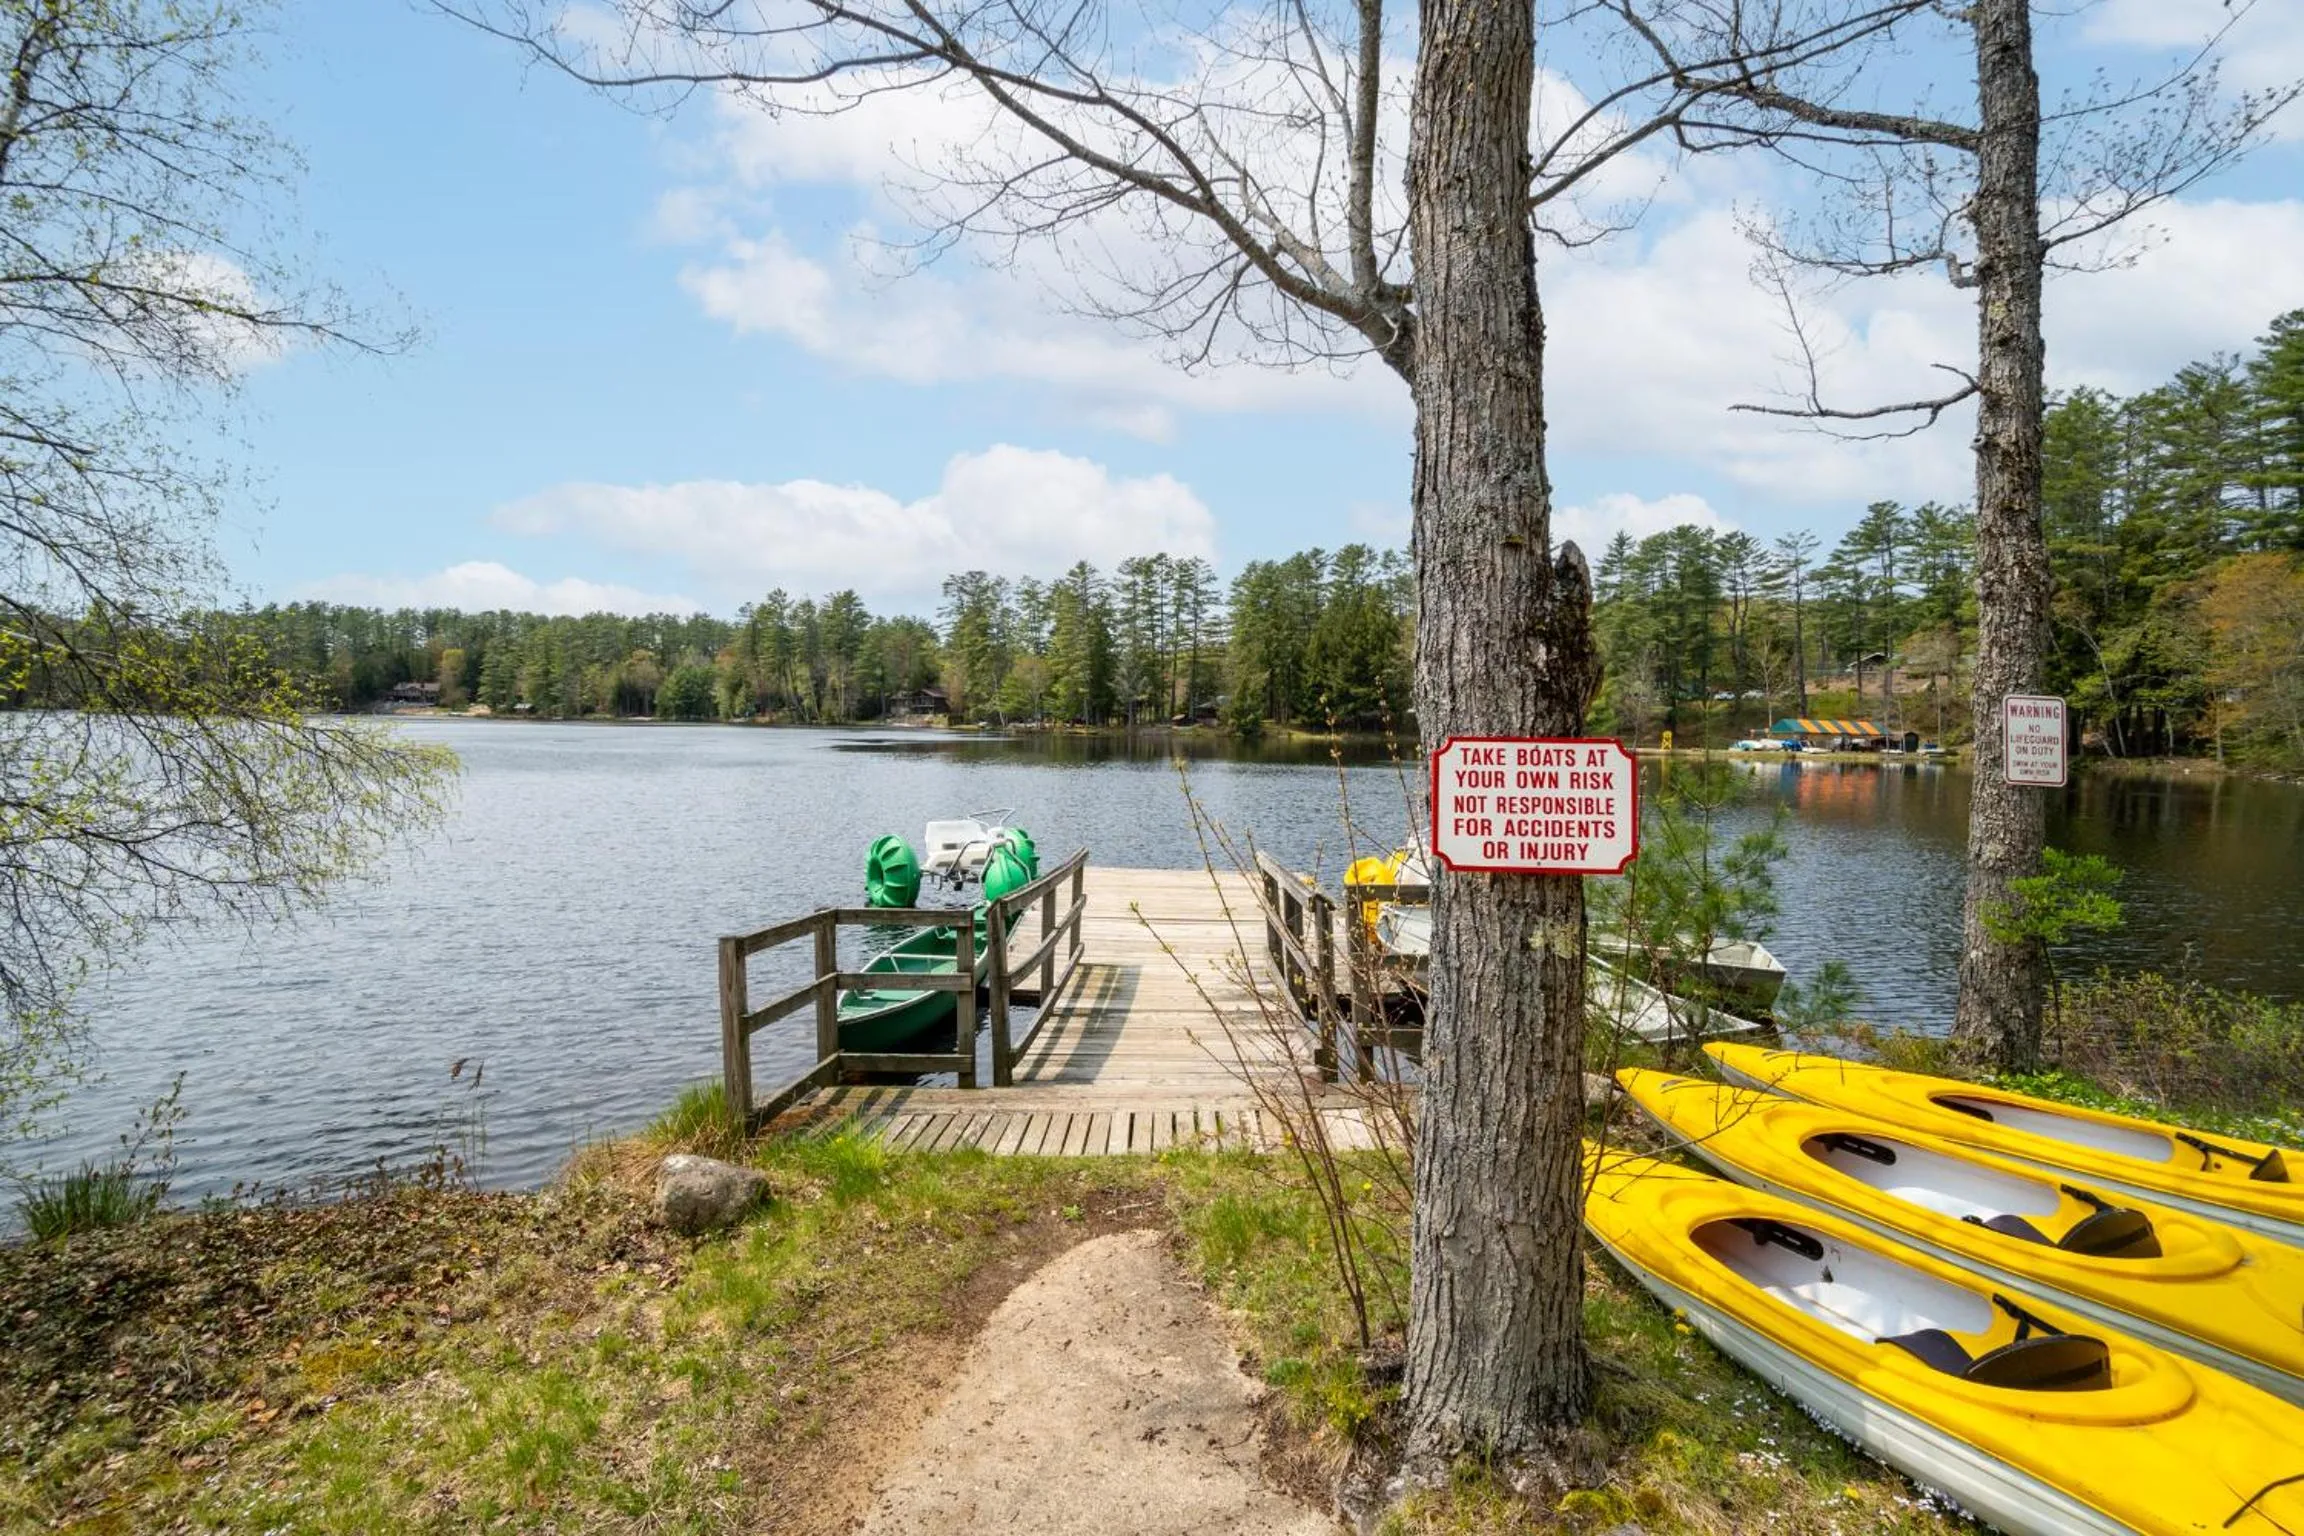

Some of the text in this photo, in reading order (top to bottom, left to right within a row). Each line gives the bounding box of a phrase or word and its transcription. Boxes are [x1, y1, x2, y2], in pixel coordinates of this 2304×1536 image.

[2010, 705, 2060, 719] WARNING
[2029, 725, 2040, 733] NO
[2010, 735, 2059, 745] LIFEGUARD
[1461, 748, 1607, 767] TAKE BOATS AT
[2015, 746, 2054, 755] ON DUTY
[1455, 770, 1613, 789] YOUR OWN RISK
[1454, 796, 1615, 815] NOT RESPONSIBLE
[1454, 818, 1615, 838] FOR ACCIDENTS
[1483, 841, 1589, 860] OR INJURY
